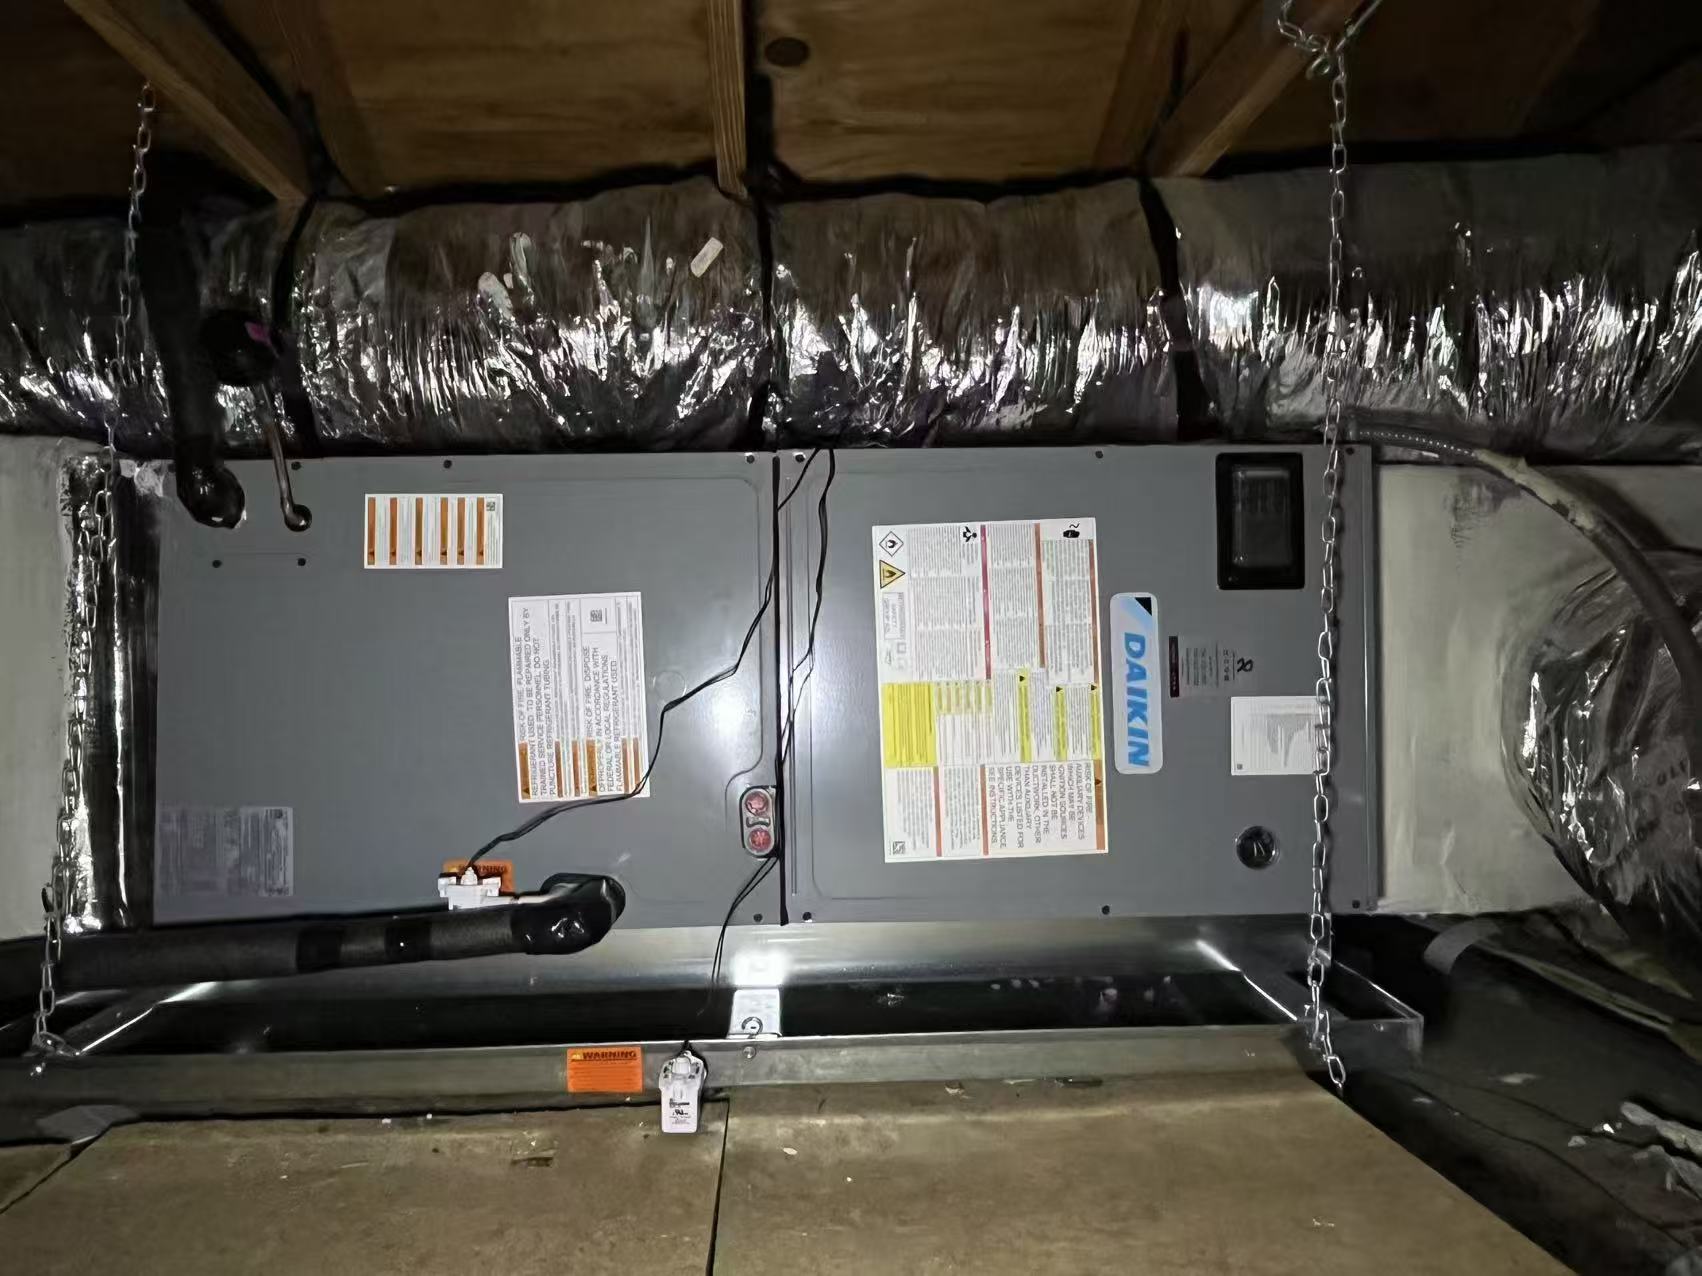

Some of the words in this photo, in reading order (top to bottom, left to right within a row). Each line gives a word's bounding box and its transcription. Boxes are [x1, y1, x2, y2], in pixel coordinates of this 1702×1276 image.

[534, 656, 540, 669] DO
[1125, 632, 1150, 767] DAIKIN
[537, 724, 545, 758] SERVICE
[582, 1051, 637, 1060] WARNING
